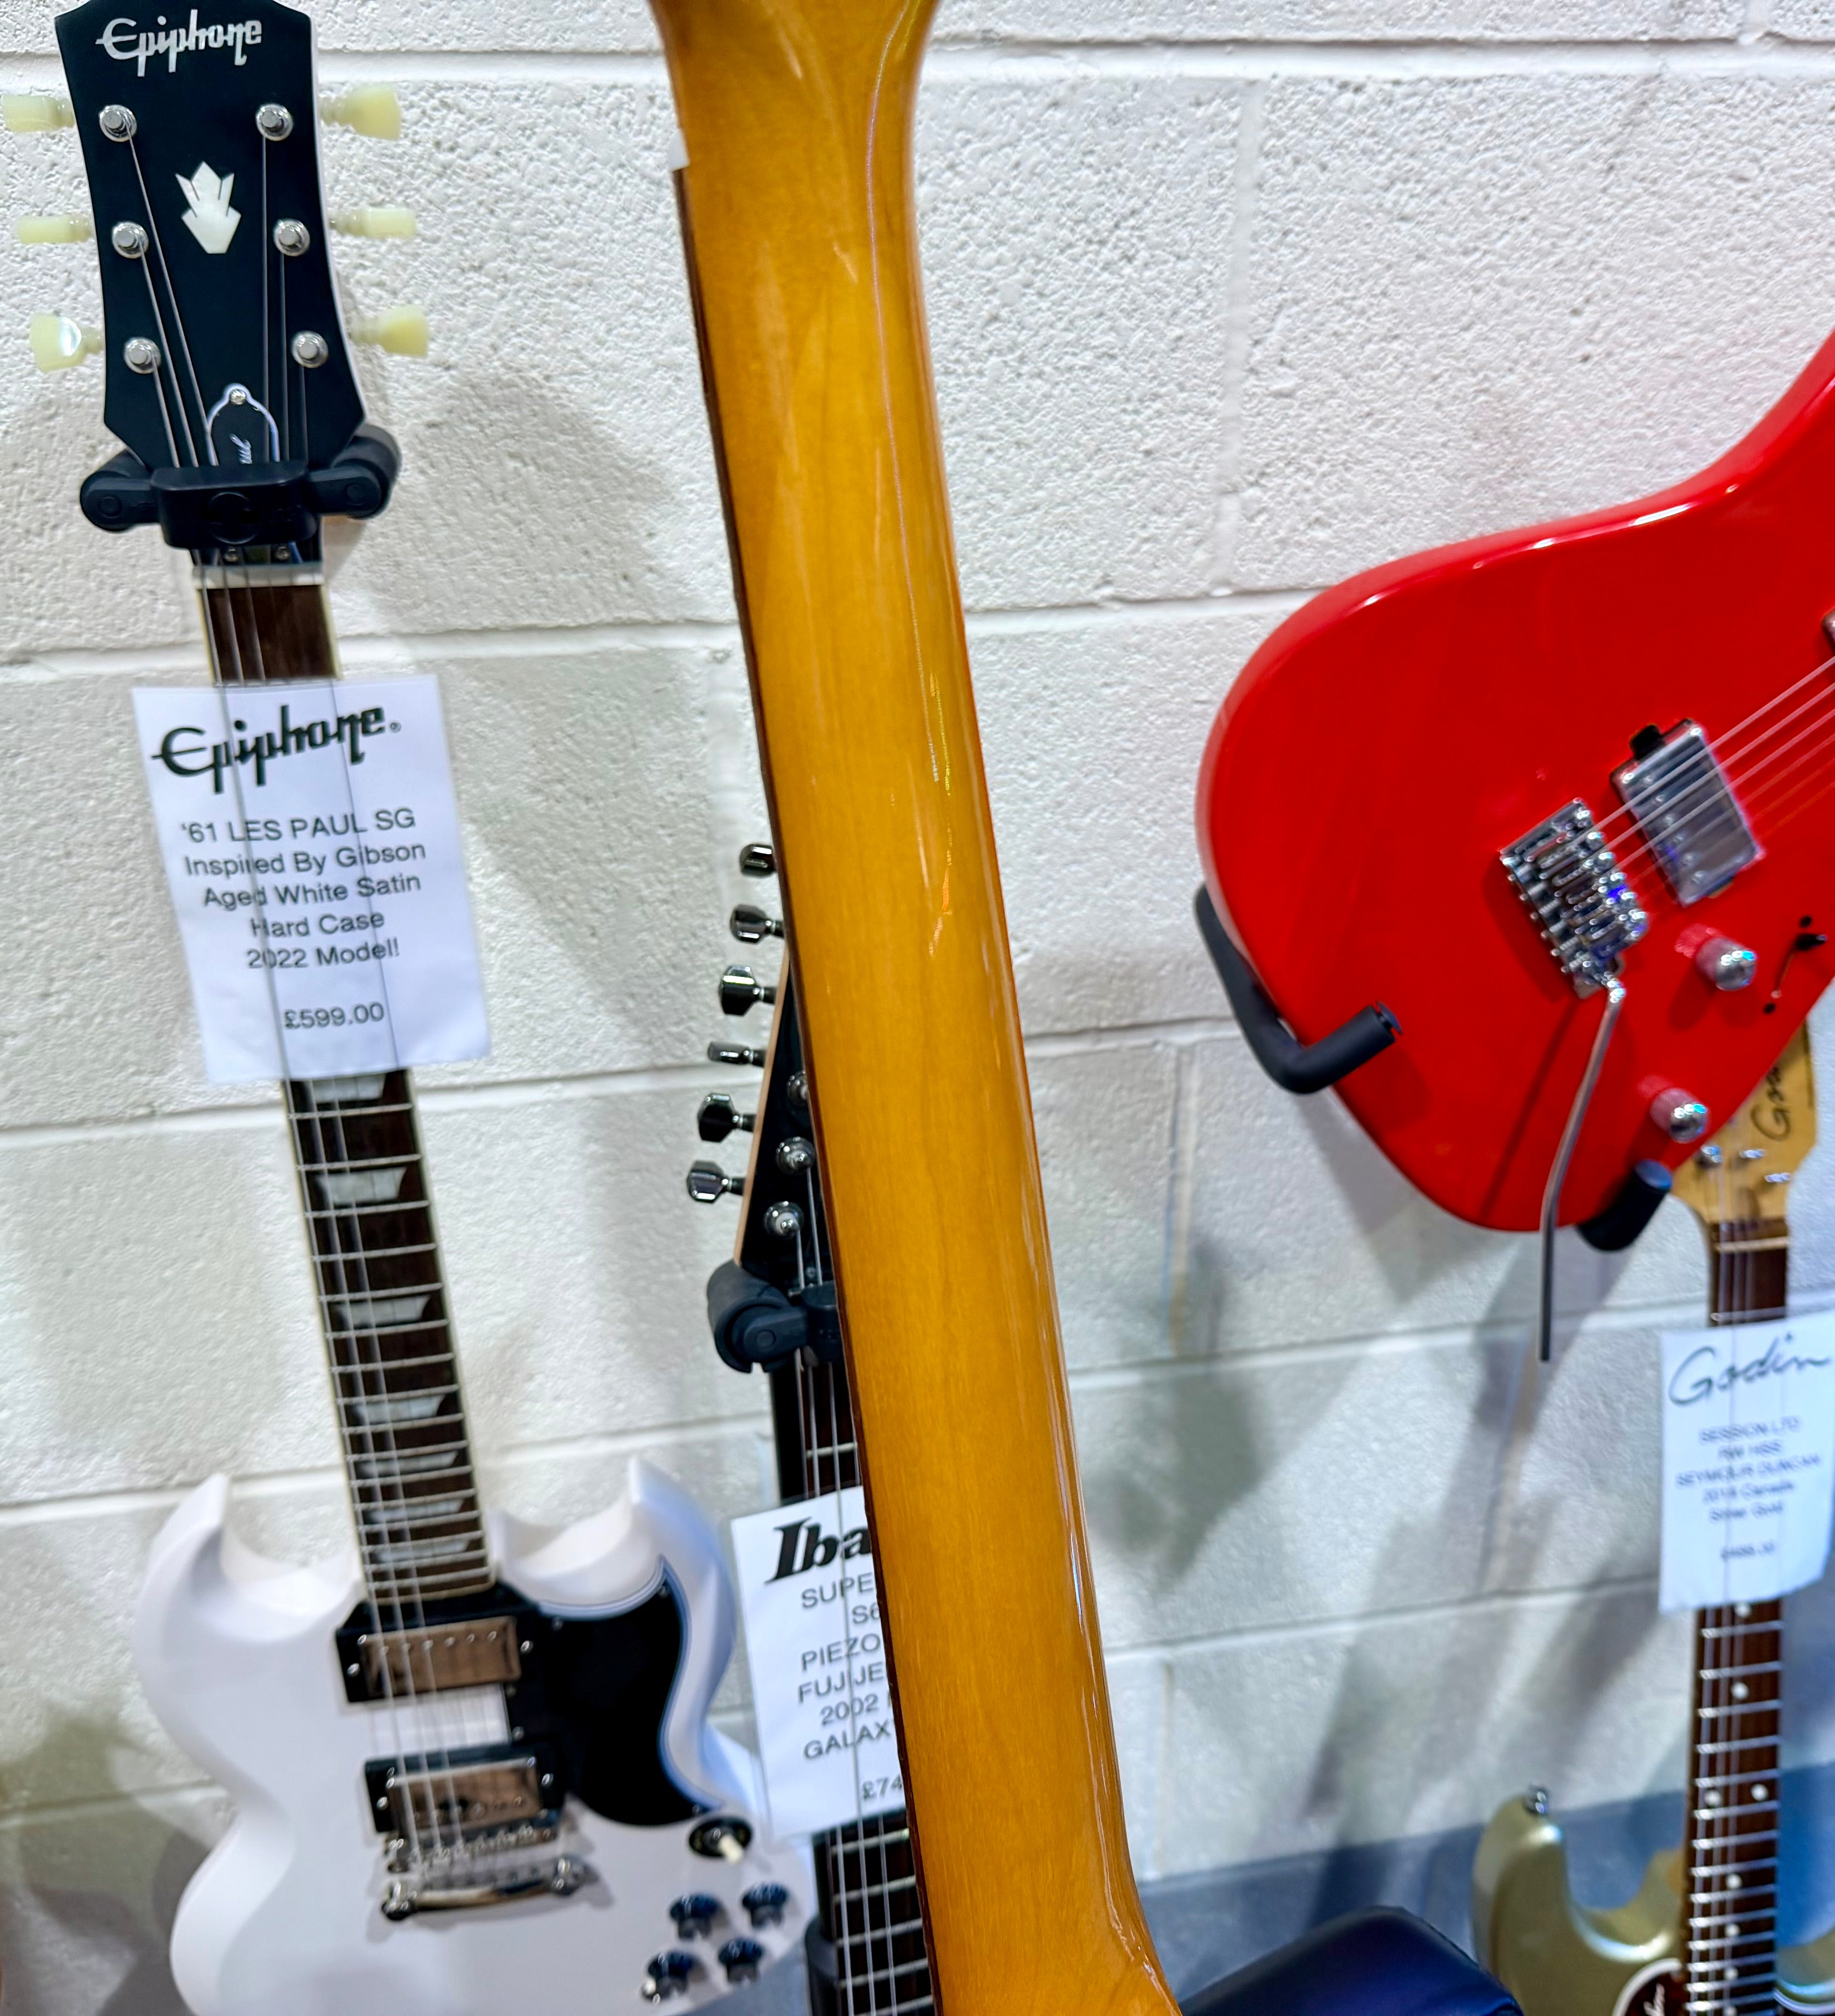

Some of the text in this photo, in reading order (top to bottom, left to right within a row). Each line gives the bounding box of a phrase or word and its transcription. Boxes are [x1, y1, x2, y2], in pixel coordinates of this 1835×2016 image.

[96, 9, 262, 77] Epiphone
[228, 820, 283, 842] LES
[291, 815, 367, 837] PAUL
[376, 808, 416, 831] SG
[185, 843, 426, 879] Inspired By Gibson
[204, 873, 421, 911] Aged White Satin
[251, 912, 385, 938] Hard Case
[247, 938, 399, 970] 2022 Model!
[285, 1002, 385, 1029] £599.00
[1669, 1333, 1830, 1405] Godin
[765, 1517, 871, 1585] Iba
[801, 1572, 874, 1609] SUPE
[801, 1633, 881, 1671] PIEZO
[799, 1661, 884, 1704] FUJJE
[820, 1693, 879, 1726] 2002
